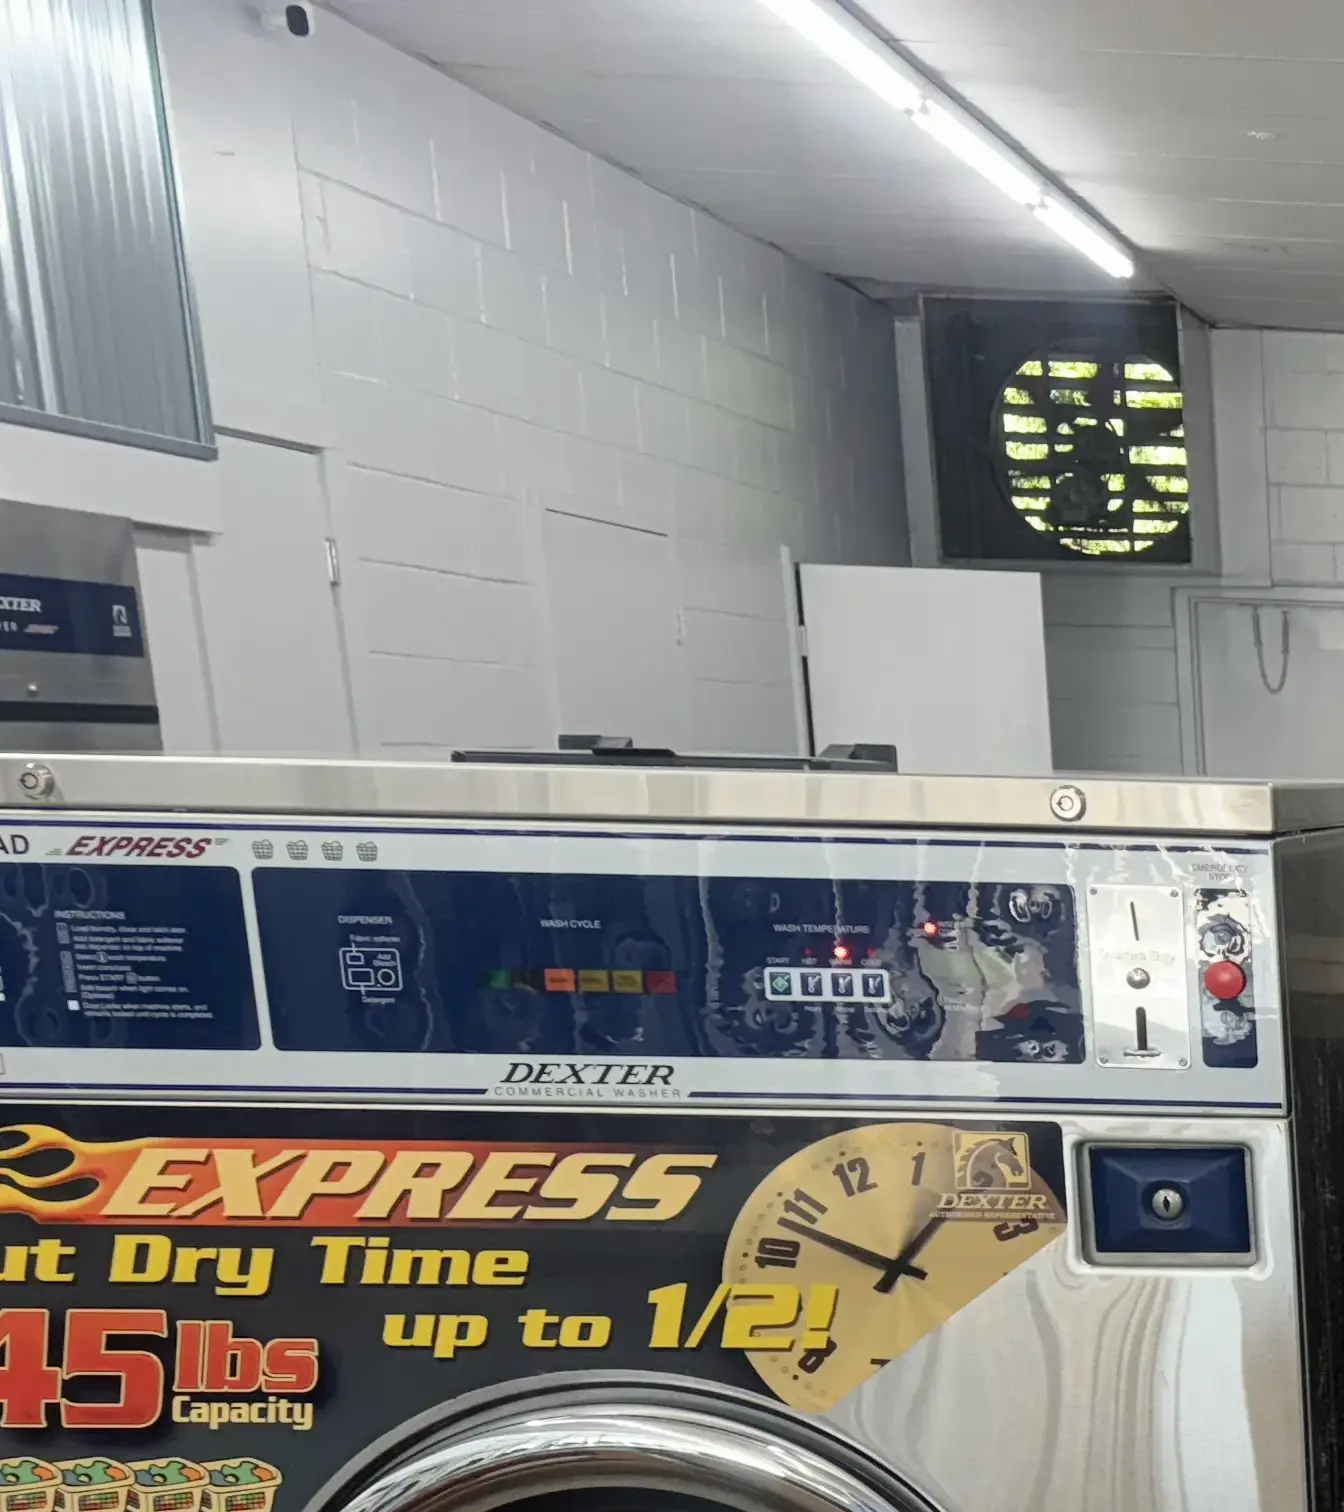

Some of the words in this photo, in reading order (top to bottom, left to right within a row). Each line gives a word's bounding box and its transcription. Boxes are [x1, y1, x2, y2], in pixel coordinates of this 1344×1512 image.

[66, 836, 213, 859] EXPRESS
[540, 919, 568, 928] WASH
[570, 919, 601, 929] CYCLE
[772, 923, 800, 932] WASH
[500, 1061, 676, 1086] DEXTER
[493, 1086, 606, 1099] COMMERCIAL
[612, 1087, 681, 1100] WASHER
[99, 1147, 718, 1221] EXPRESS
[832, 1157, 878, 1198] 12
[909, 1151, 926, 1187] 1
[783, 1187, 829, 1227] 11
[937, 1193, 1047, 1209] DEXTER
[991, 1217, 1040, 1245] 3
[108, 1234, 275, 1296] Dry
[310, 1236, 531, 1286] Time
[754, 1237, 802, 1270] 10
[381, 1311, 489, 1360] up
[517, 1309, 612, 1349] to
[647, 1281, 841, 1352] 1/2!
[173, 1319, 320, 1395] lbs
[171, 1396, 314, 1431] Capacity
